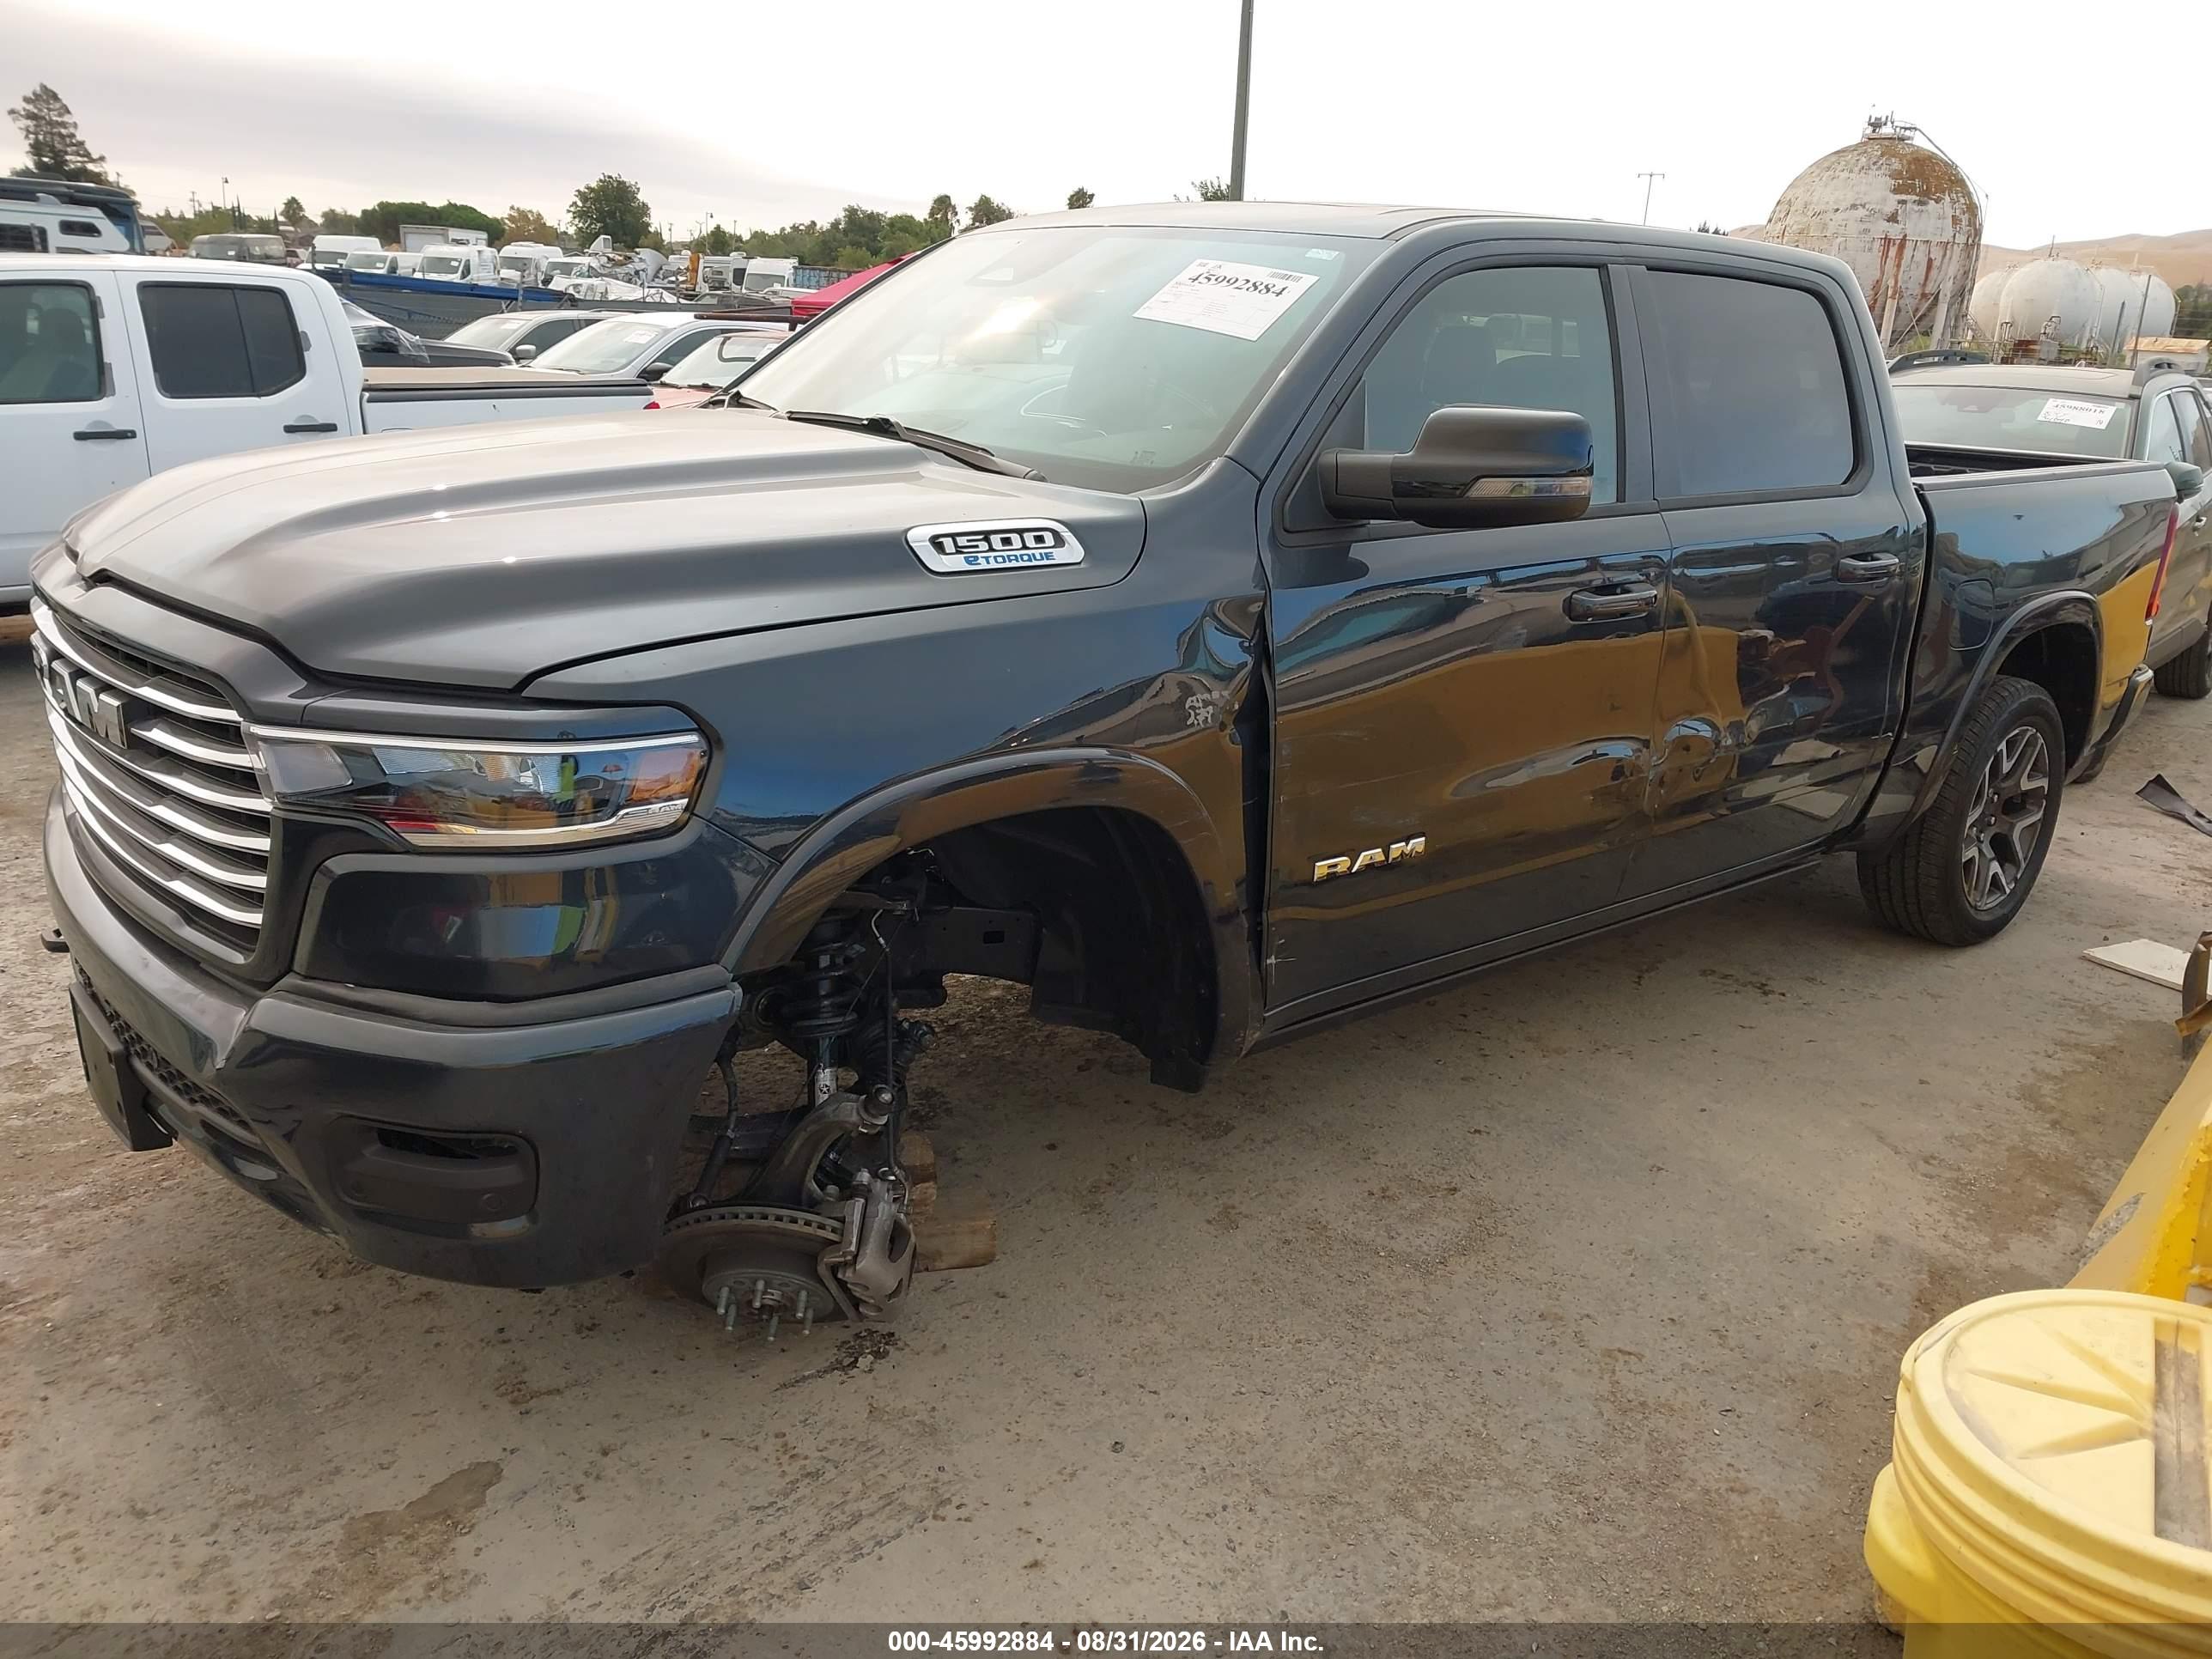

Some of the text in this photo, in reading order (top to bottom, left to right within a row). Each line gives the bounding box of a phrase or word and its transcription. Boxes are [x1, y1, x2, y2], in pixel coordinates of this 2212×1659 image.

[1188, 272, 1289, 298] 45992884
[934, 531, 1055, 554] 1500
[1313, 836, 1426, 883] RAM
